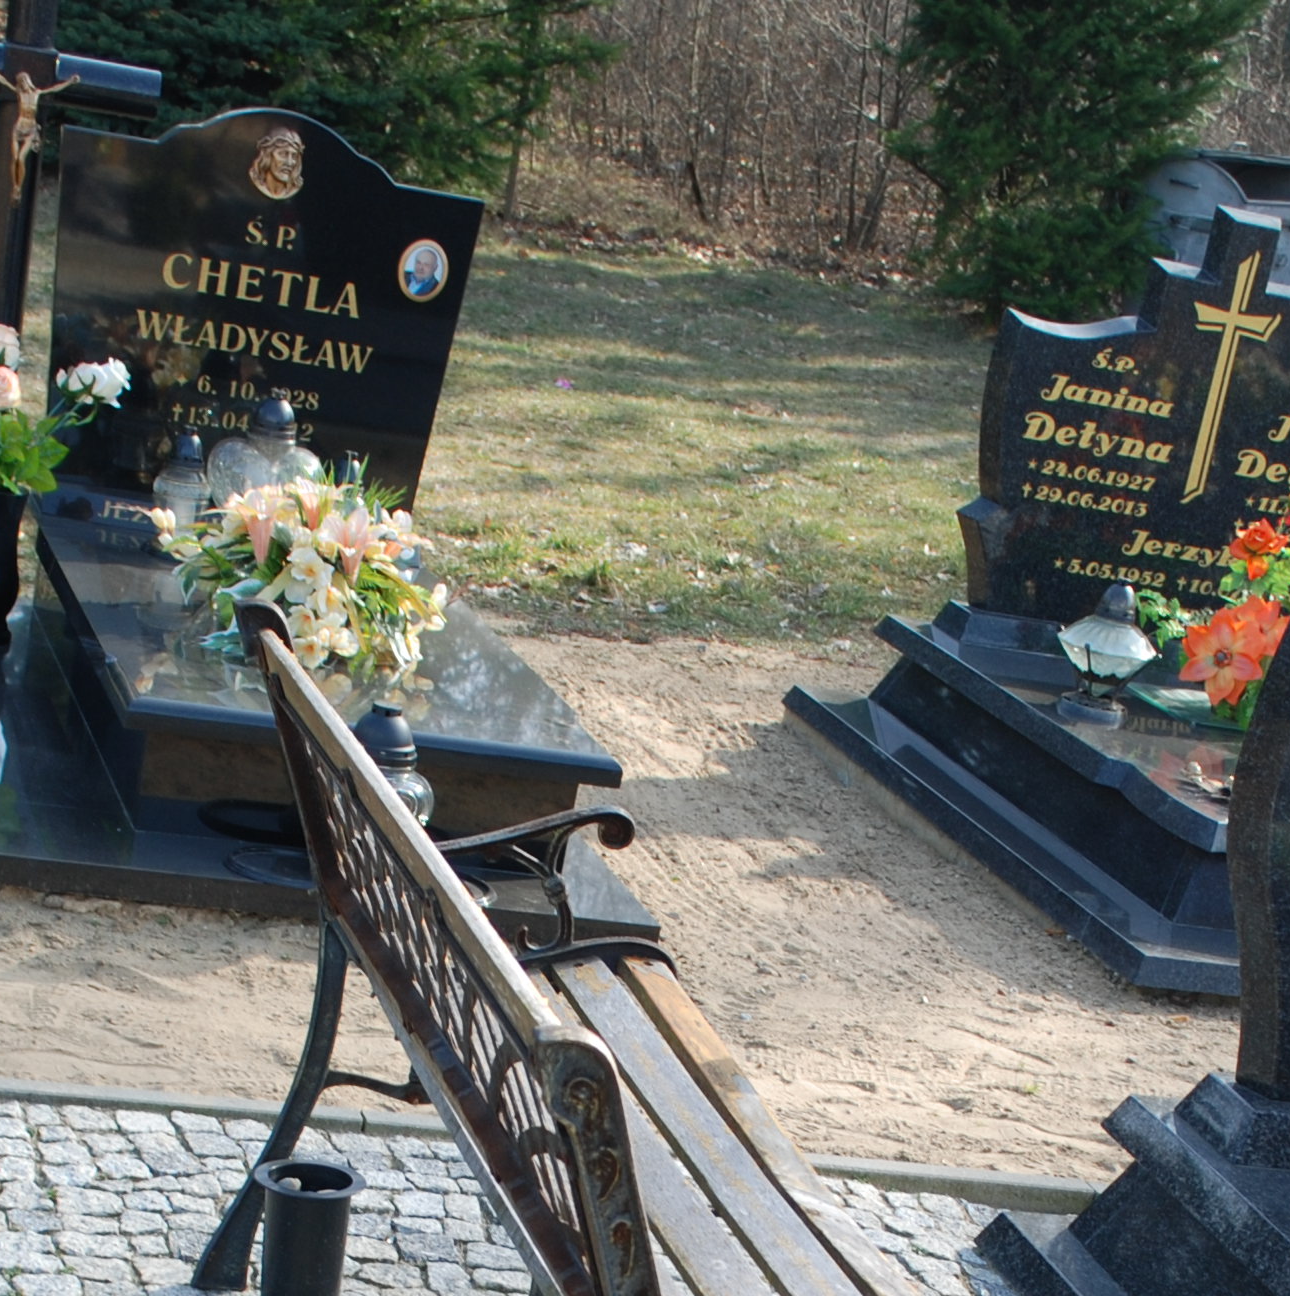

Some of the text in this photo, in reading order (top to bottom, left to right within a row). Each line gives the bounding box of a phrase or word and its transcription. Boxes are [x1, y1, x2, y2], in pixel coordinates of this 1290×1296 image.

[162, 253, 360, 320] CHETLA
[136, 308, 374, 374] WŁADYSŁAW
[1091, 347, 1140, 375] Ś.P.
[1040, 373, 1174, 418] Janina
[1022, 411, 1174, 463] Detyna
[1041, 459, 1156, 492] 24.06.1927
[1035, 486, 1149, 517] 29.06.2013
[1067, 559, 1165, 587] 5.05.1952
